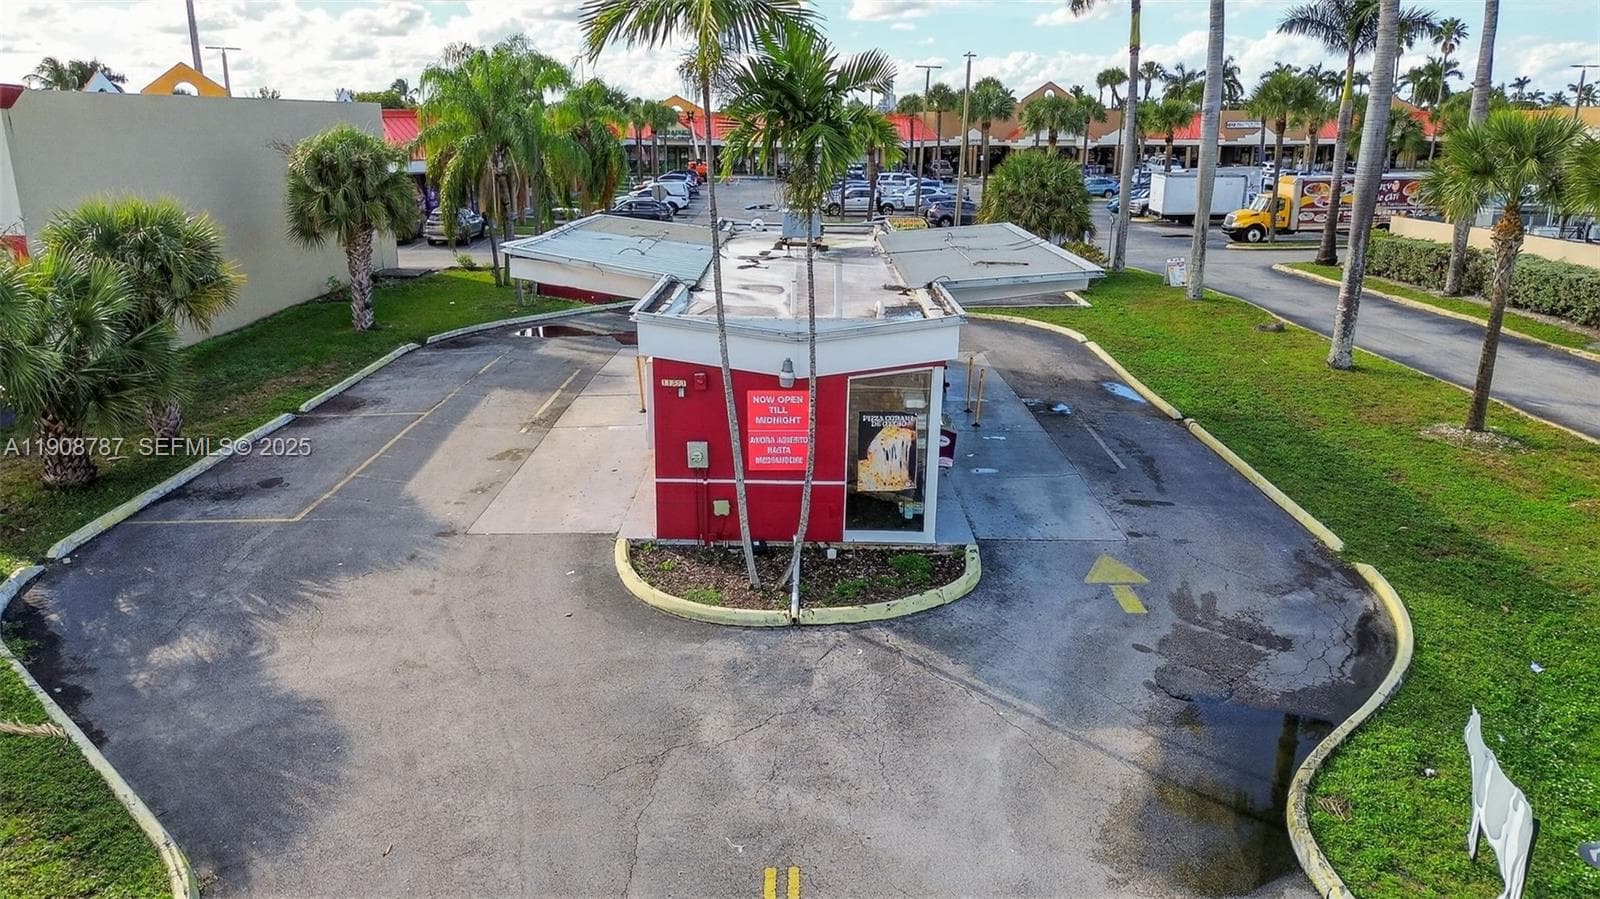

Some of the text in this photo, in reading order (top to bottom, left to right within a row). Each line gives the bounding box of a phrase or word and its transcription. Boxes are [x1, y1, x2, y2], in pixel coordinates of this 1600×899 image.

[752, 395, 803, 404] NOW OPEN
[768, 406, 788, 414] TILL
[755, 416, 801, 424] MIDNIGHT
